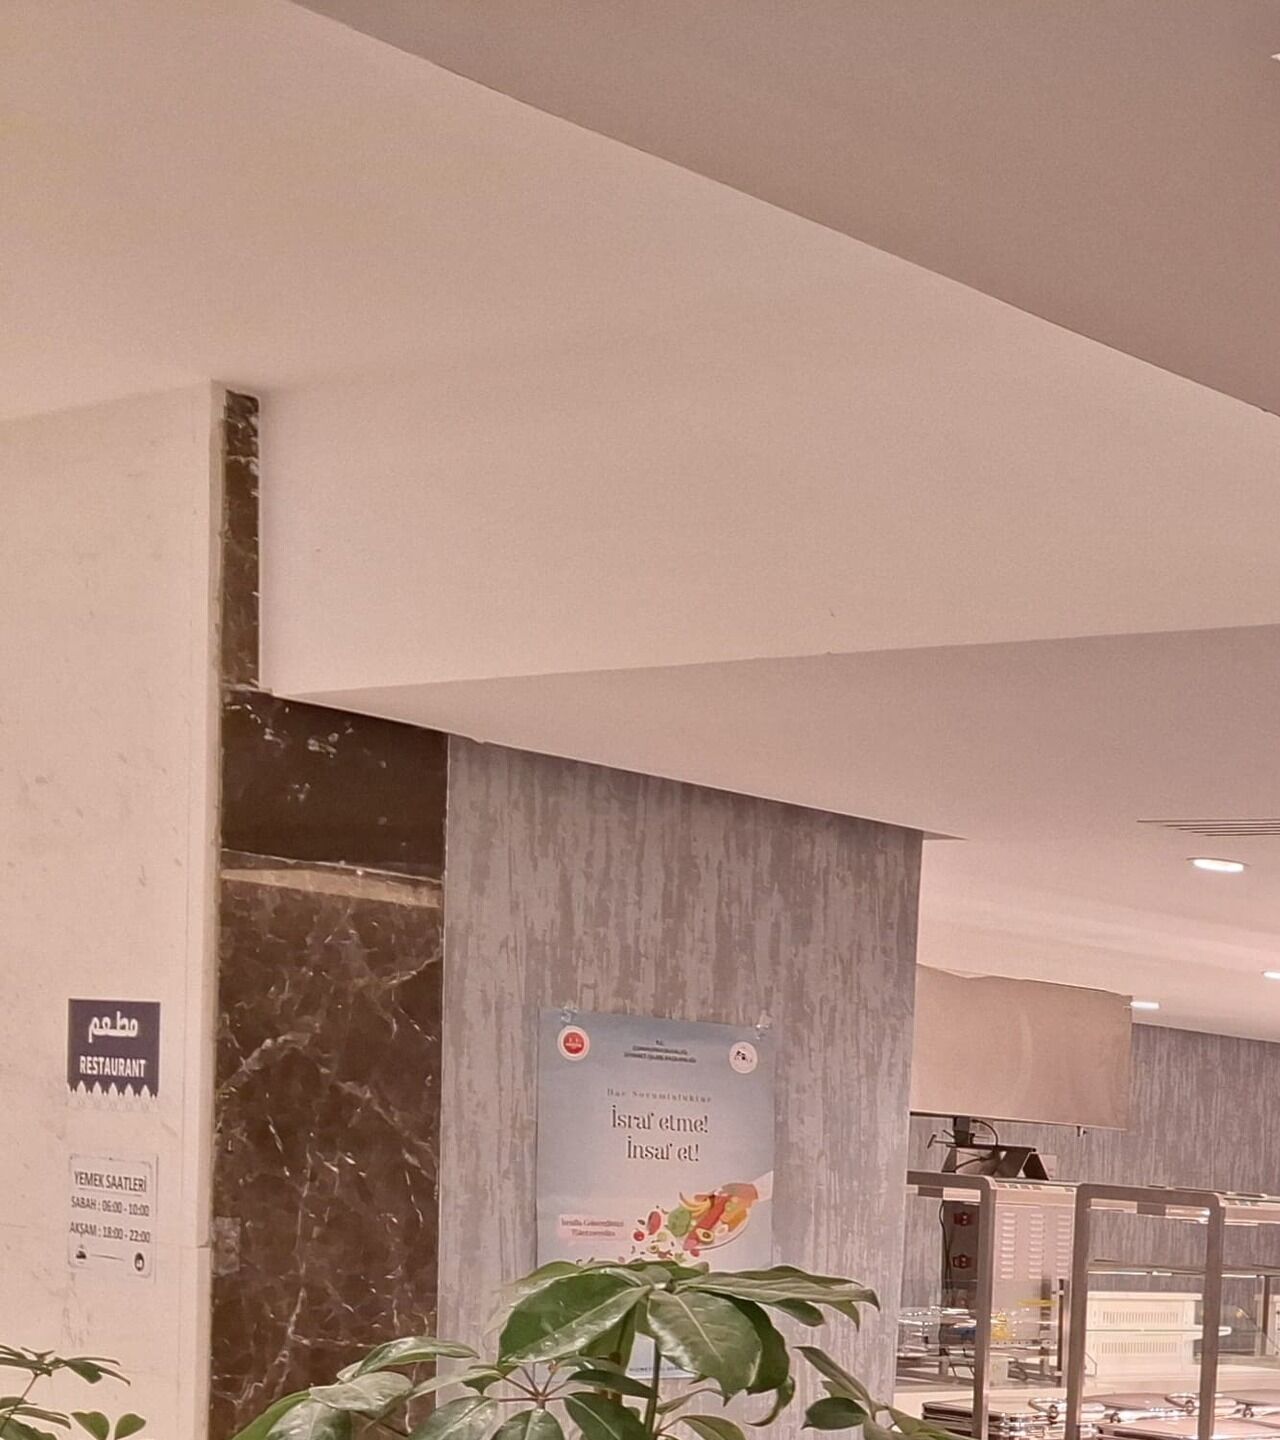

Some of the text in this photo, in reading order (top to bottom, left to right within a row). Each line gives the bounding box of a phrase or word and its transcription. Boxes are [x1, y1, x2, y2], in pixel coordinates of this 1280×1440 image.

[88, 1010, 138, 1043] مطعم
[80, 1055, 146, 1077] RESTAURANT
[612, 1104, 708, 1133] İsraf etme!
[628, 1135, 699, 1161] İnsaf et!
[74, 1171, 147, 1192] YEMEK SAATLERİ
[71, 1196, 96, 1210] SABAH
[69, 1221, 97, 1237] AKŞAM
[130, 1229, 151, 1243] 22:00
